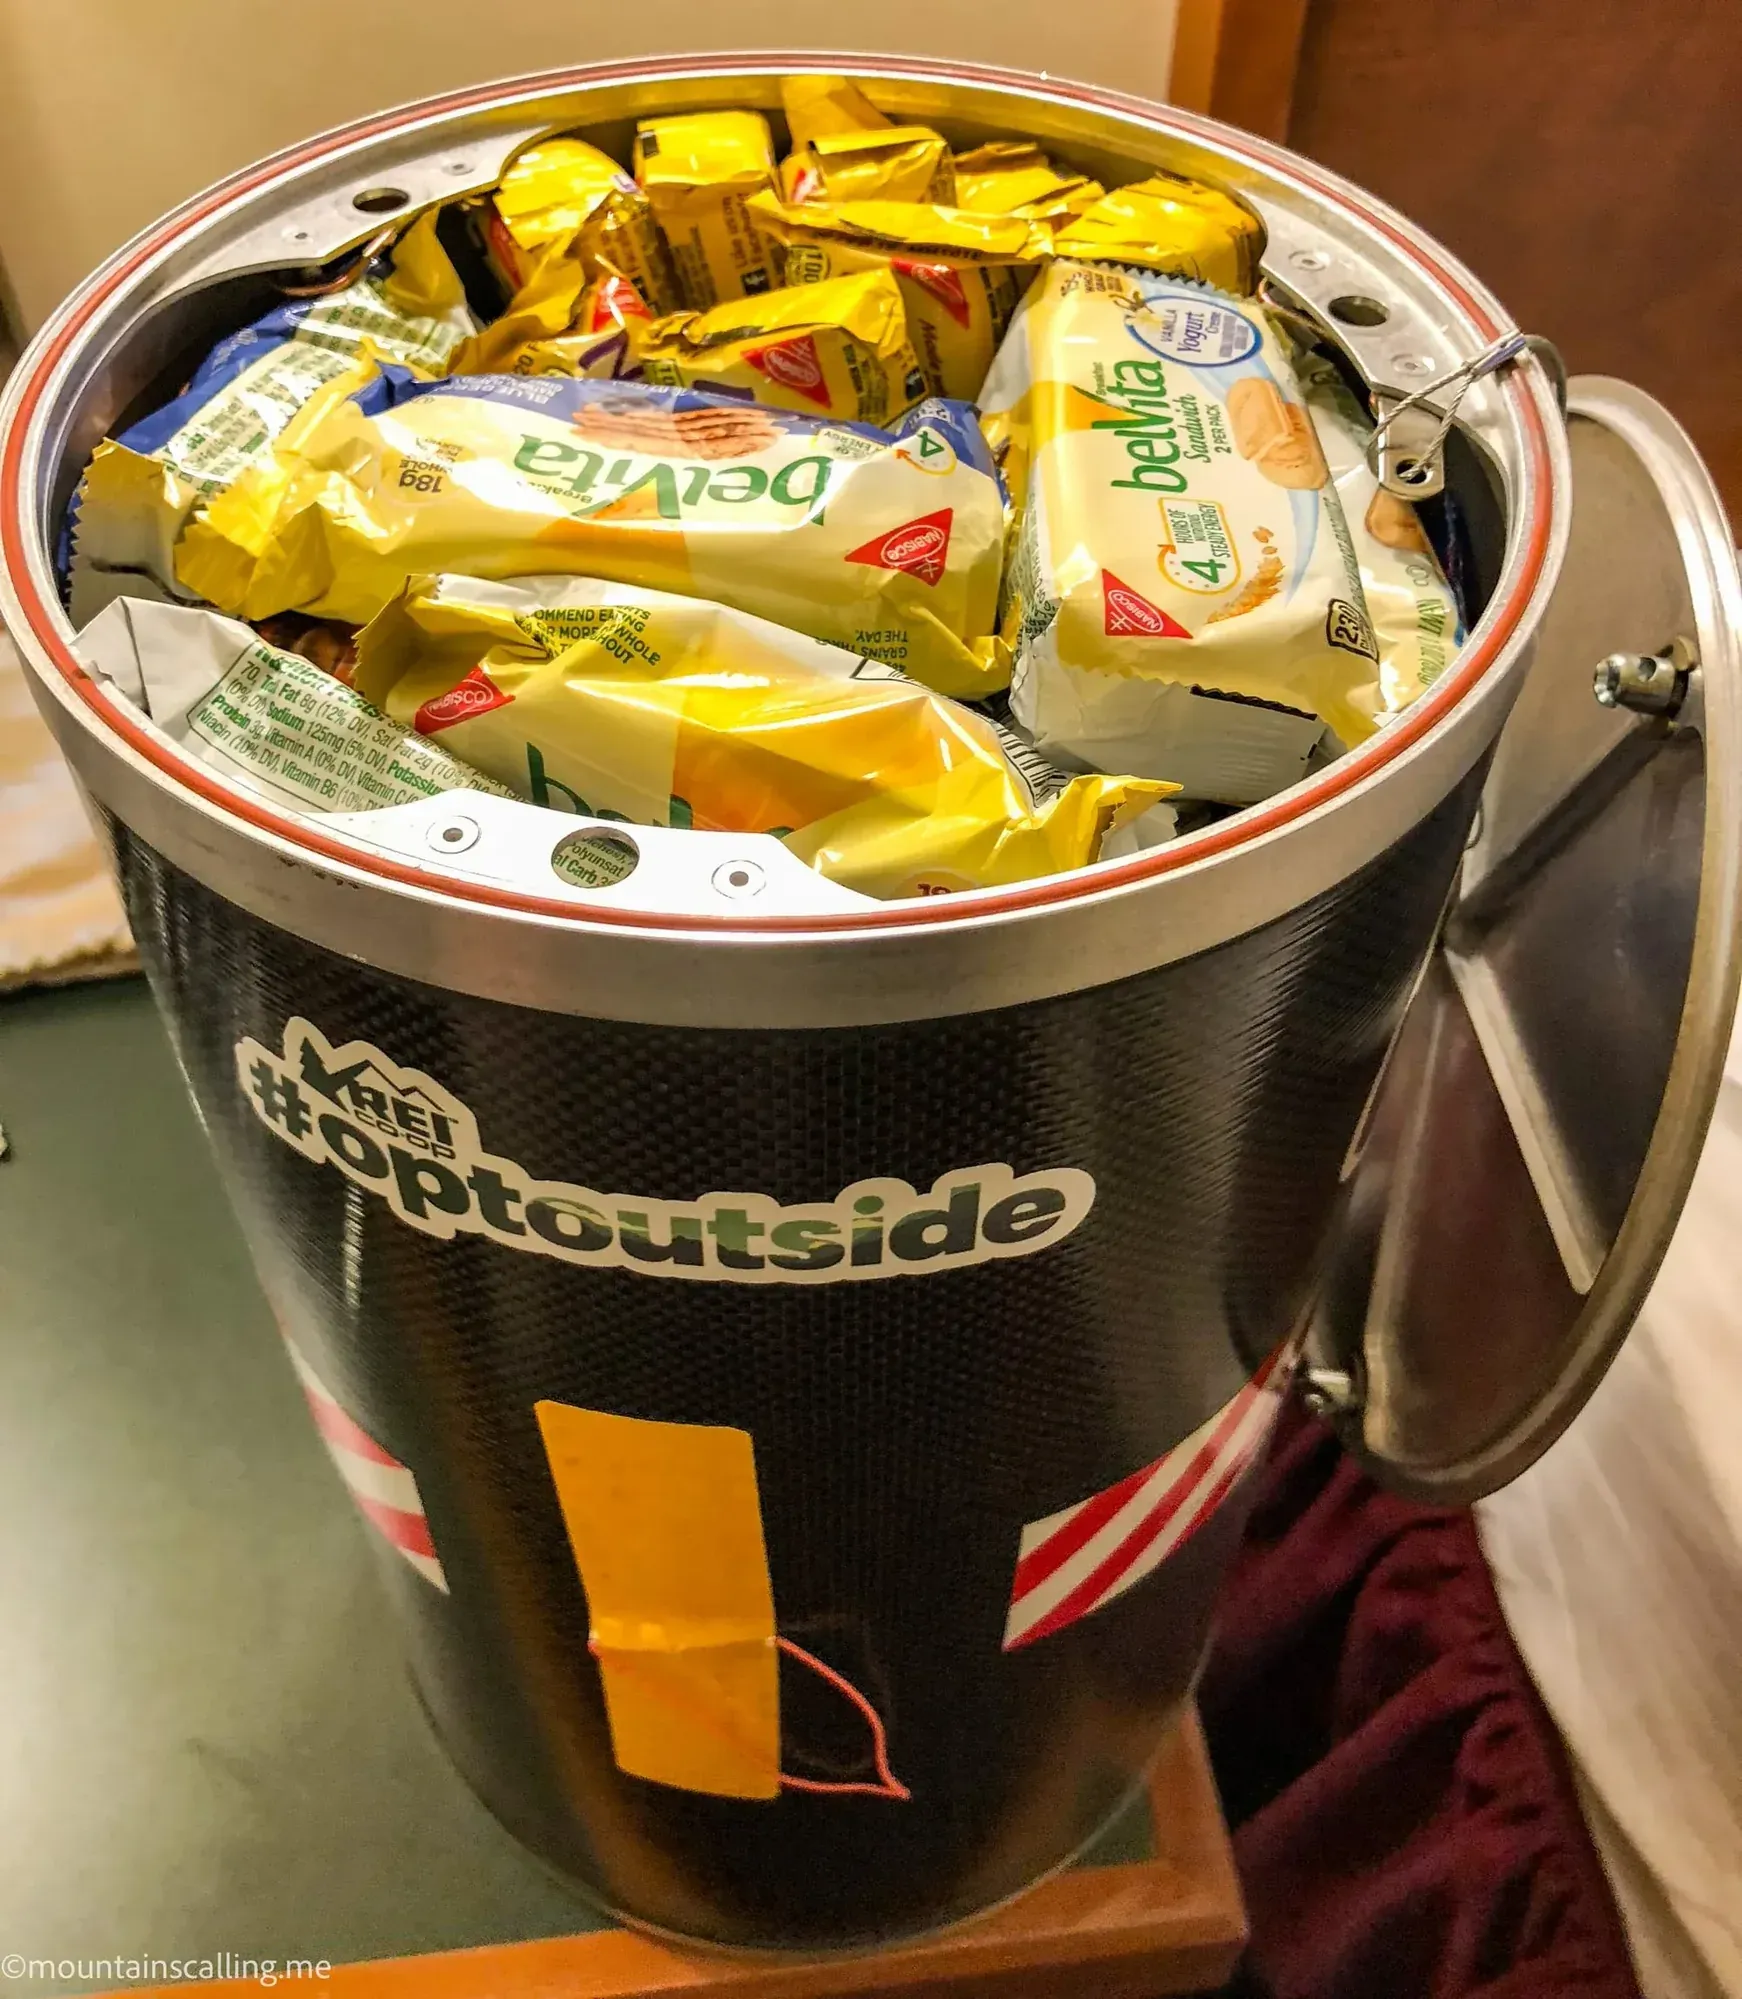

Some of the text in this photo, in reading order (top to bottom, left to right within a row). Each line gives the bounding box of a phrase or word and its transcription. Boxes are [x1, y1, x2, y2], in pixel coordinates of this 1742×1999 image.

[1177, 311, 1207, 352] Yogurt
[918, 430, 945, 457] 4
[1092, 360, 1188, 493] belVita
[1172, 393, 1211, 463] Sandwich
[1205, 404, 1232, 454] 2 PER PACK
[398, 469, 443, 493] 18g
[513, 433, 834, 527] belVita
[1170, 519, 1194, 543] HOURS
[1198, 503, 1231, 558] STEADY ENERGY
[1181, 559, 1226, 583] 4
[534, 609, 595, 621] OMMEND
[1112, 593, 1160, 629] NABISCO
[1335, 604, 1359, 644] 230
[614, 626, 660, 665] WHOLE
[862, 646, 907, 659] GRAINS
[885, 630, 908, 642] THE
[211, 694, 251, 729] Protein
[264, 726, 305, 758] Vitamin
[303, 744, 315, 765] A
[314, 748, 336, 772] (0%
[357, 768, 396, 801] Vitamin
[266, 701, 305, 731] Sodium
[306, 720, 346, 754] 125mg
[344, 737, 365, 763] (5%
[278, 682, 301, 704] Fat
[300, 693, 317, 714] 8g
[315, 700, 348, 727] (12%
[372, 728, 394, 748] Sat
[414, 752, 432, 771] 2g
[432, 761, 465, 787] (10%
[197, 707, 232, 741] Niacin
[229, 735, 259, 760] (10%
[281, 758, 321, 791] Vitamin
[320, 777, 339, 800] B6
[567, 859, 597, 884] Carb
[249, 1057, 1069, 1271] #optoutside
